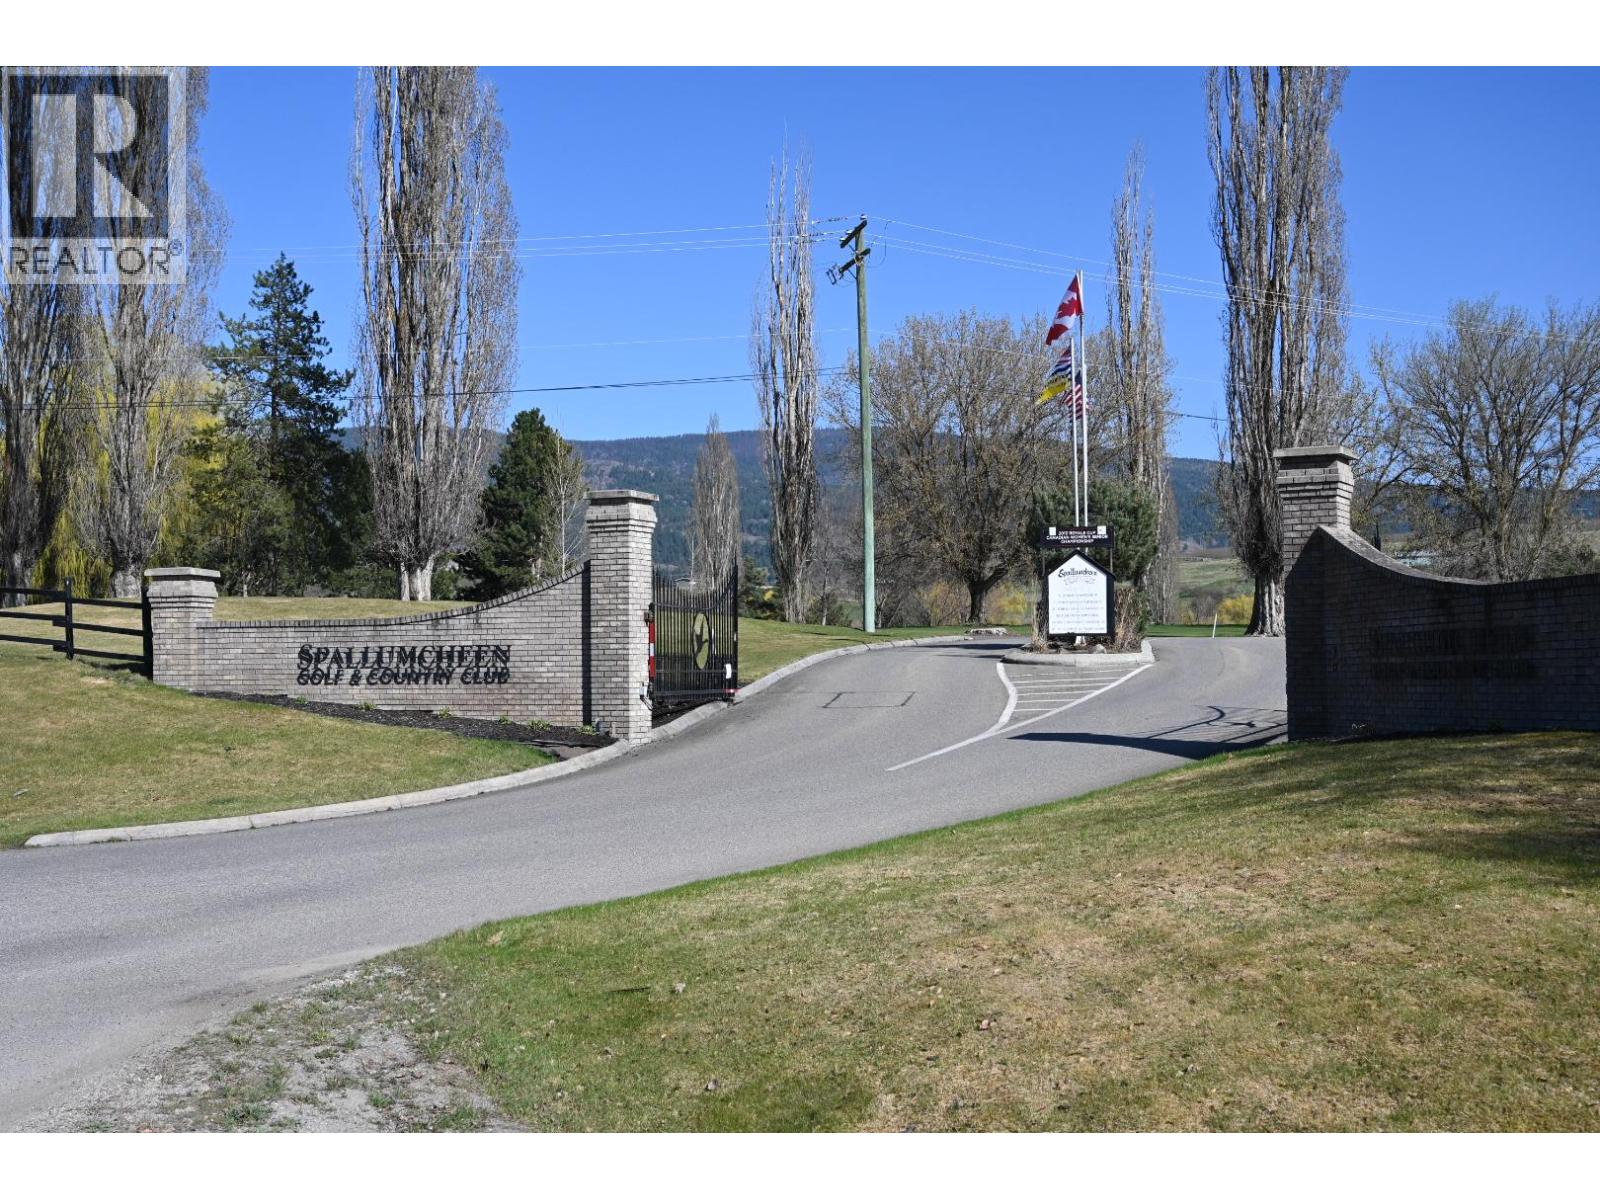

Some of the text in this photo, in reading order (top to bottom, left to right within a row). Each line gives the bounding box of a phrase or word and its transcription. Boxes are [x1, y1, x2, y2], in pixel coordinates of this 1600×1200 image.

[296, 667, 511, 686] GOLF & COUNTRY CLUB
